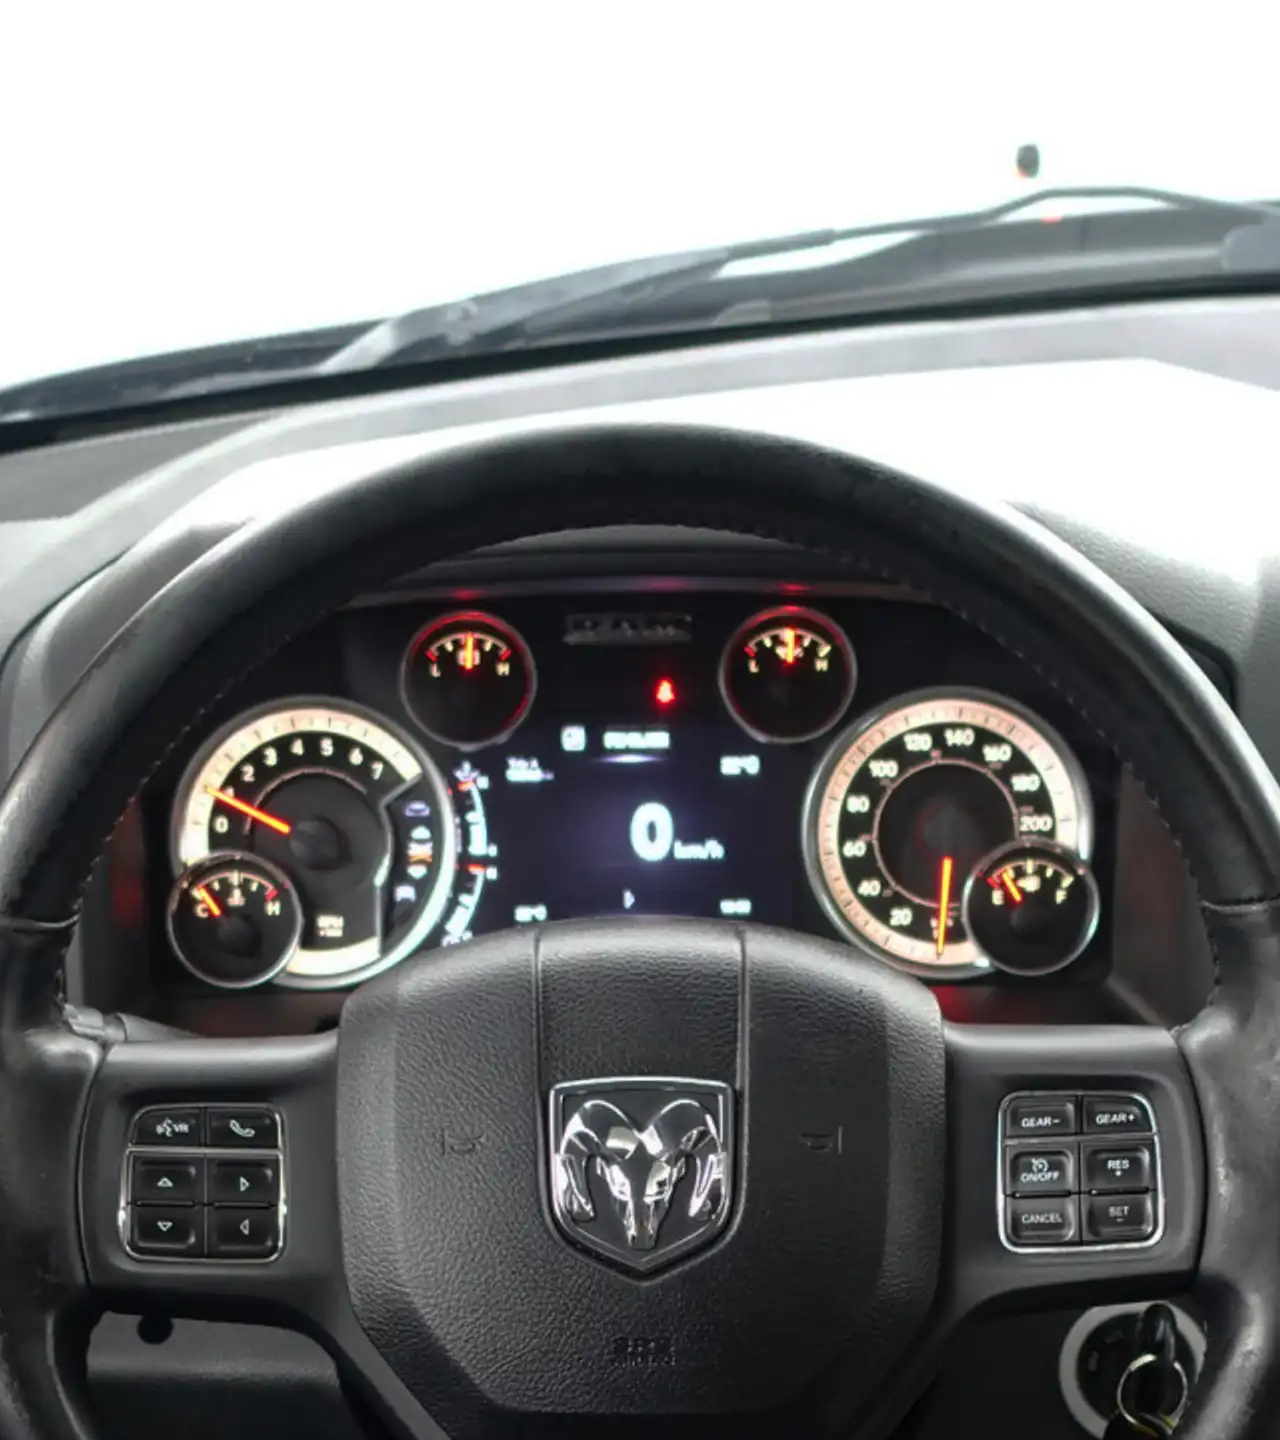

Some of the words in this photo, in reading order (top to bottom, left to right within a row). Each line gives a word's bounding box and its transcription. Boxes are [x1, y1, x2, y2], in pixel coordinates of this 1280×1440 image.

[903, 732, 933, 751] 120
[944, 728, 975, 747] 140
[290, 738, 305, 756] 4
[320, 738, 334, 757] 5
[982, 744, 1013, 763] 160
[264, 747, 278, 766] 3
[348, 747, 364, 766] 6
[240, 764, 256, 783] 2
[371, 761, 385, 780] 7
[869, 760, 899, 778] 100
[846, 795, 870, 813] 80
[214, 814, 229, 833] 0
[629, 802, 674, 862] 0
[674, 837, 725, 860] km/h
[1020, 814, 1053, 832] 200
[842, 840, 866, 857] 60
[858, 880, 881, 896] 40
[992, 889, 1005, 905] E
[1056, 889, 1068, 904] F
[265, 900, 281, 916] H
[889, 907, 913, 926] 20
[1107, 1159, 1130, 1170] RES
[1021, 1170, 1060, 1183] ON/OFF
[1022, 1213, 1064, 1225] CANCEL
[1108, 1205, 1130, 1218] SET
